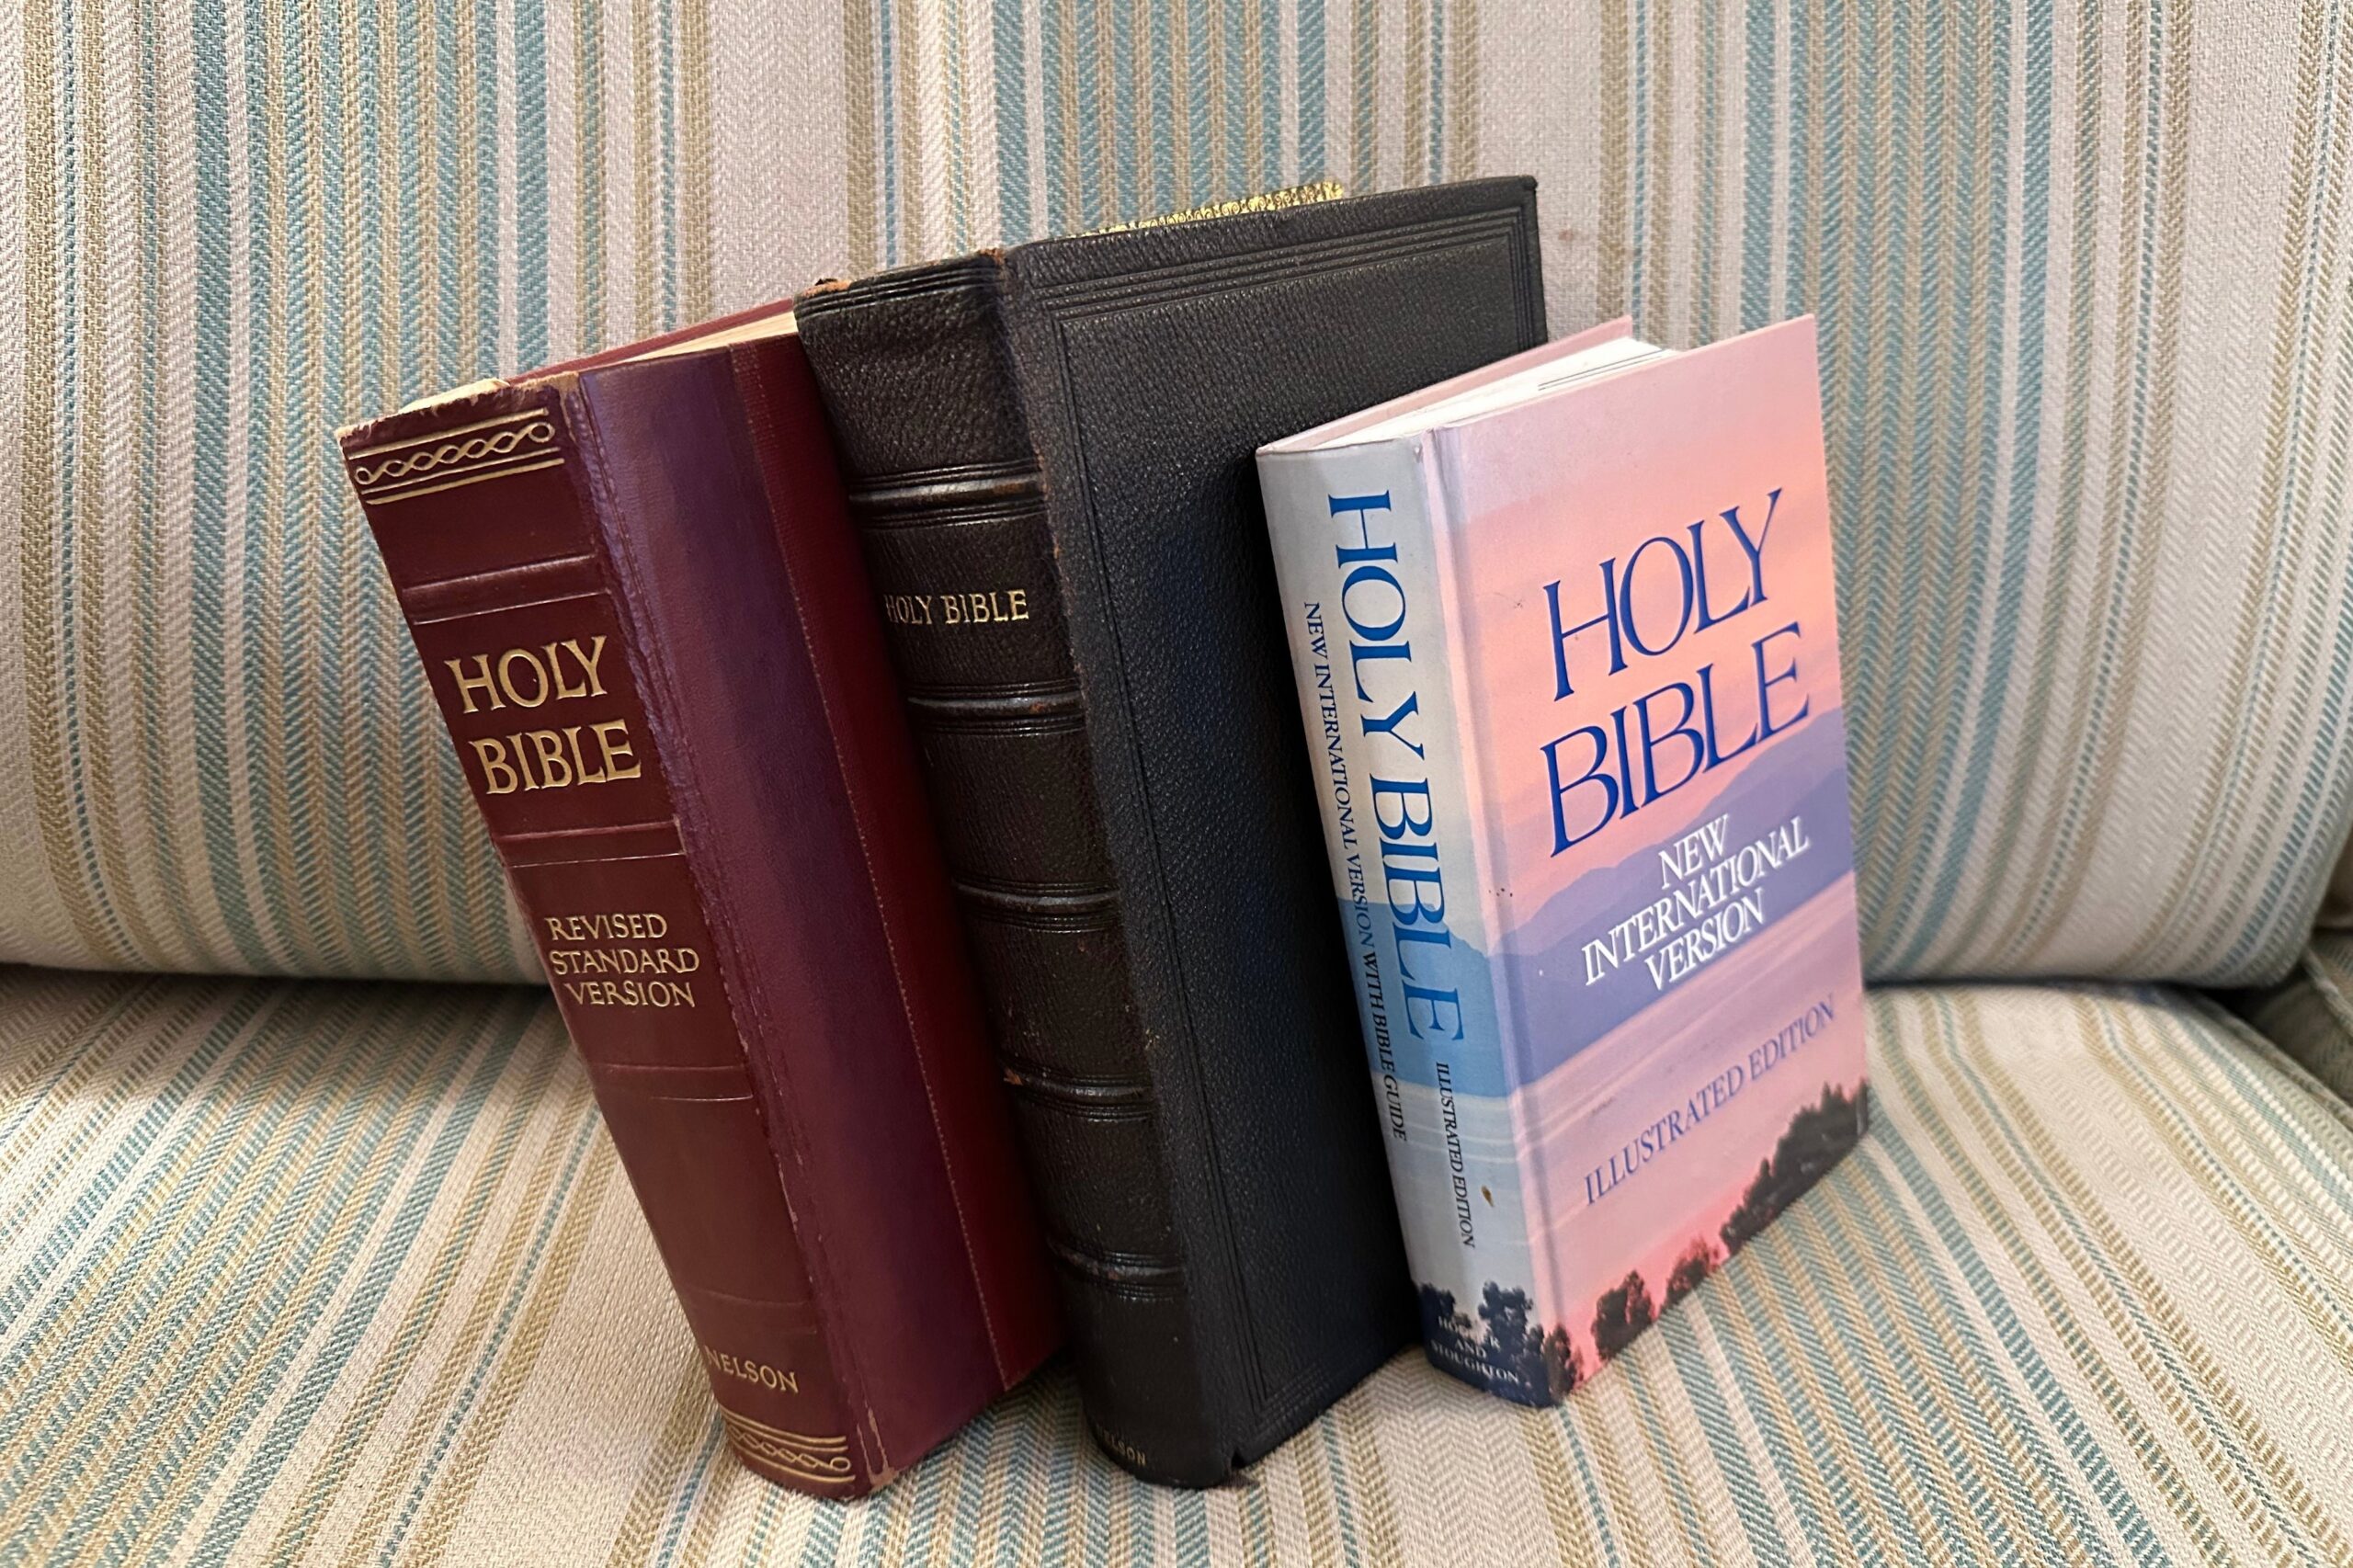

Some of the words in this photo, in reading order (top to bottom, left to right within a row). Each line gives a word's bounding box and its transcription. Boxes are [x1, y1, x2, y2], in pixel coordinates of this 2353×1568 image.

[883, 595, 933, 625] HOLY
[940, 588, 1029, 625] BIBLE
[1303, 602, 1328, 659] NEW
[1328, 489, 1426, 761] HOLY
[1542, 487, 1782, 702] HOLY
[444, 634, 608, 715] HOLY
[469, 719, 642, 796] BIBLE
[1314, 664, 1358, 850] INTERNATIONAL
[1540, 621, 1810, 858] BIBLE
[1658, 812, 1730, 890] NEW
[544, 913, 668, 940] REVISED
[1347, 853, 1375, 948] VERSION
[1369, 773, 1464, 1041] BIBLE
[1581, 814, 1813, 986] INTERNATIONAL
[1643, 886, 1765, 991] VERSION
[549, 948, 700, 975] STANDARD
[564, 980, 696, 1007] VERSION
[1363, 950, 1384, 1012] WITH
[1372, 1013, 1396, 1074] BIBLE
[1383, 1074, 1407, 1142] GUIDE
[1583, 1064, 1745, 1206] ILLUSTRATED
[1748, 992, 1836, 1083] EDITION
[1436, 1062, 1464, 1173] ILLUSTRATED
[1452, 1173, 1476, 1249] EDITION
[704, 1345, 799, 1394] NELSON
[1455, 1338, 1487, 1359] AND
